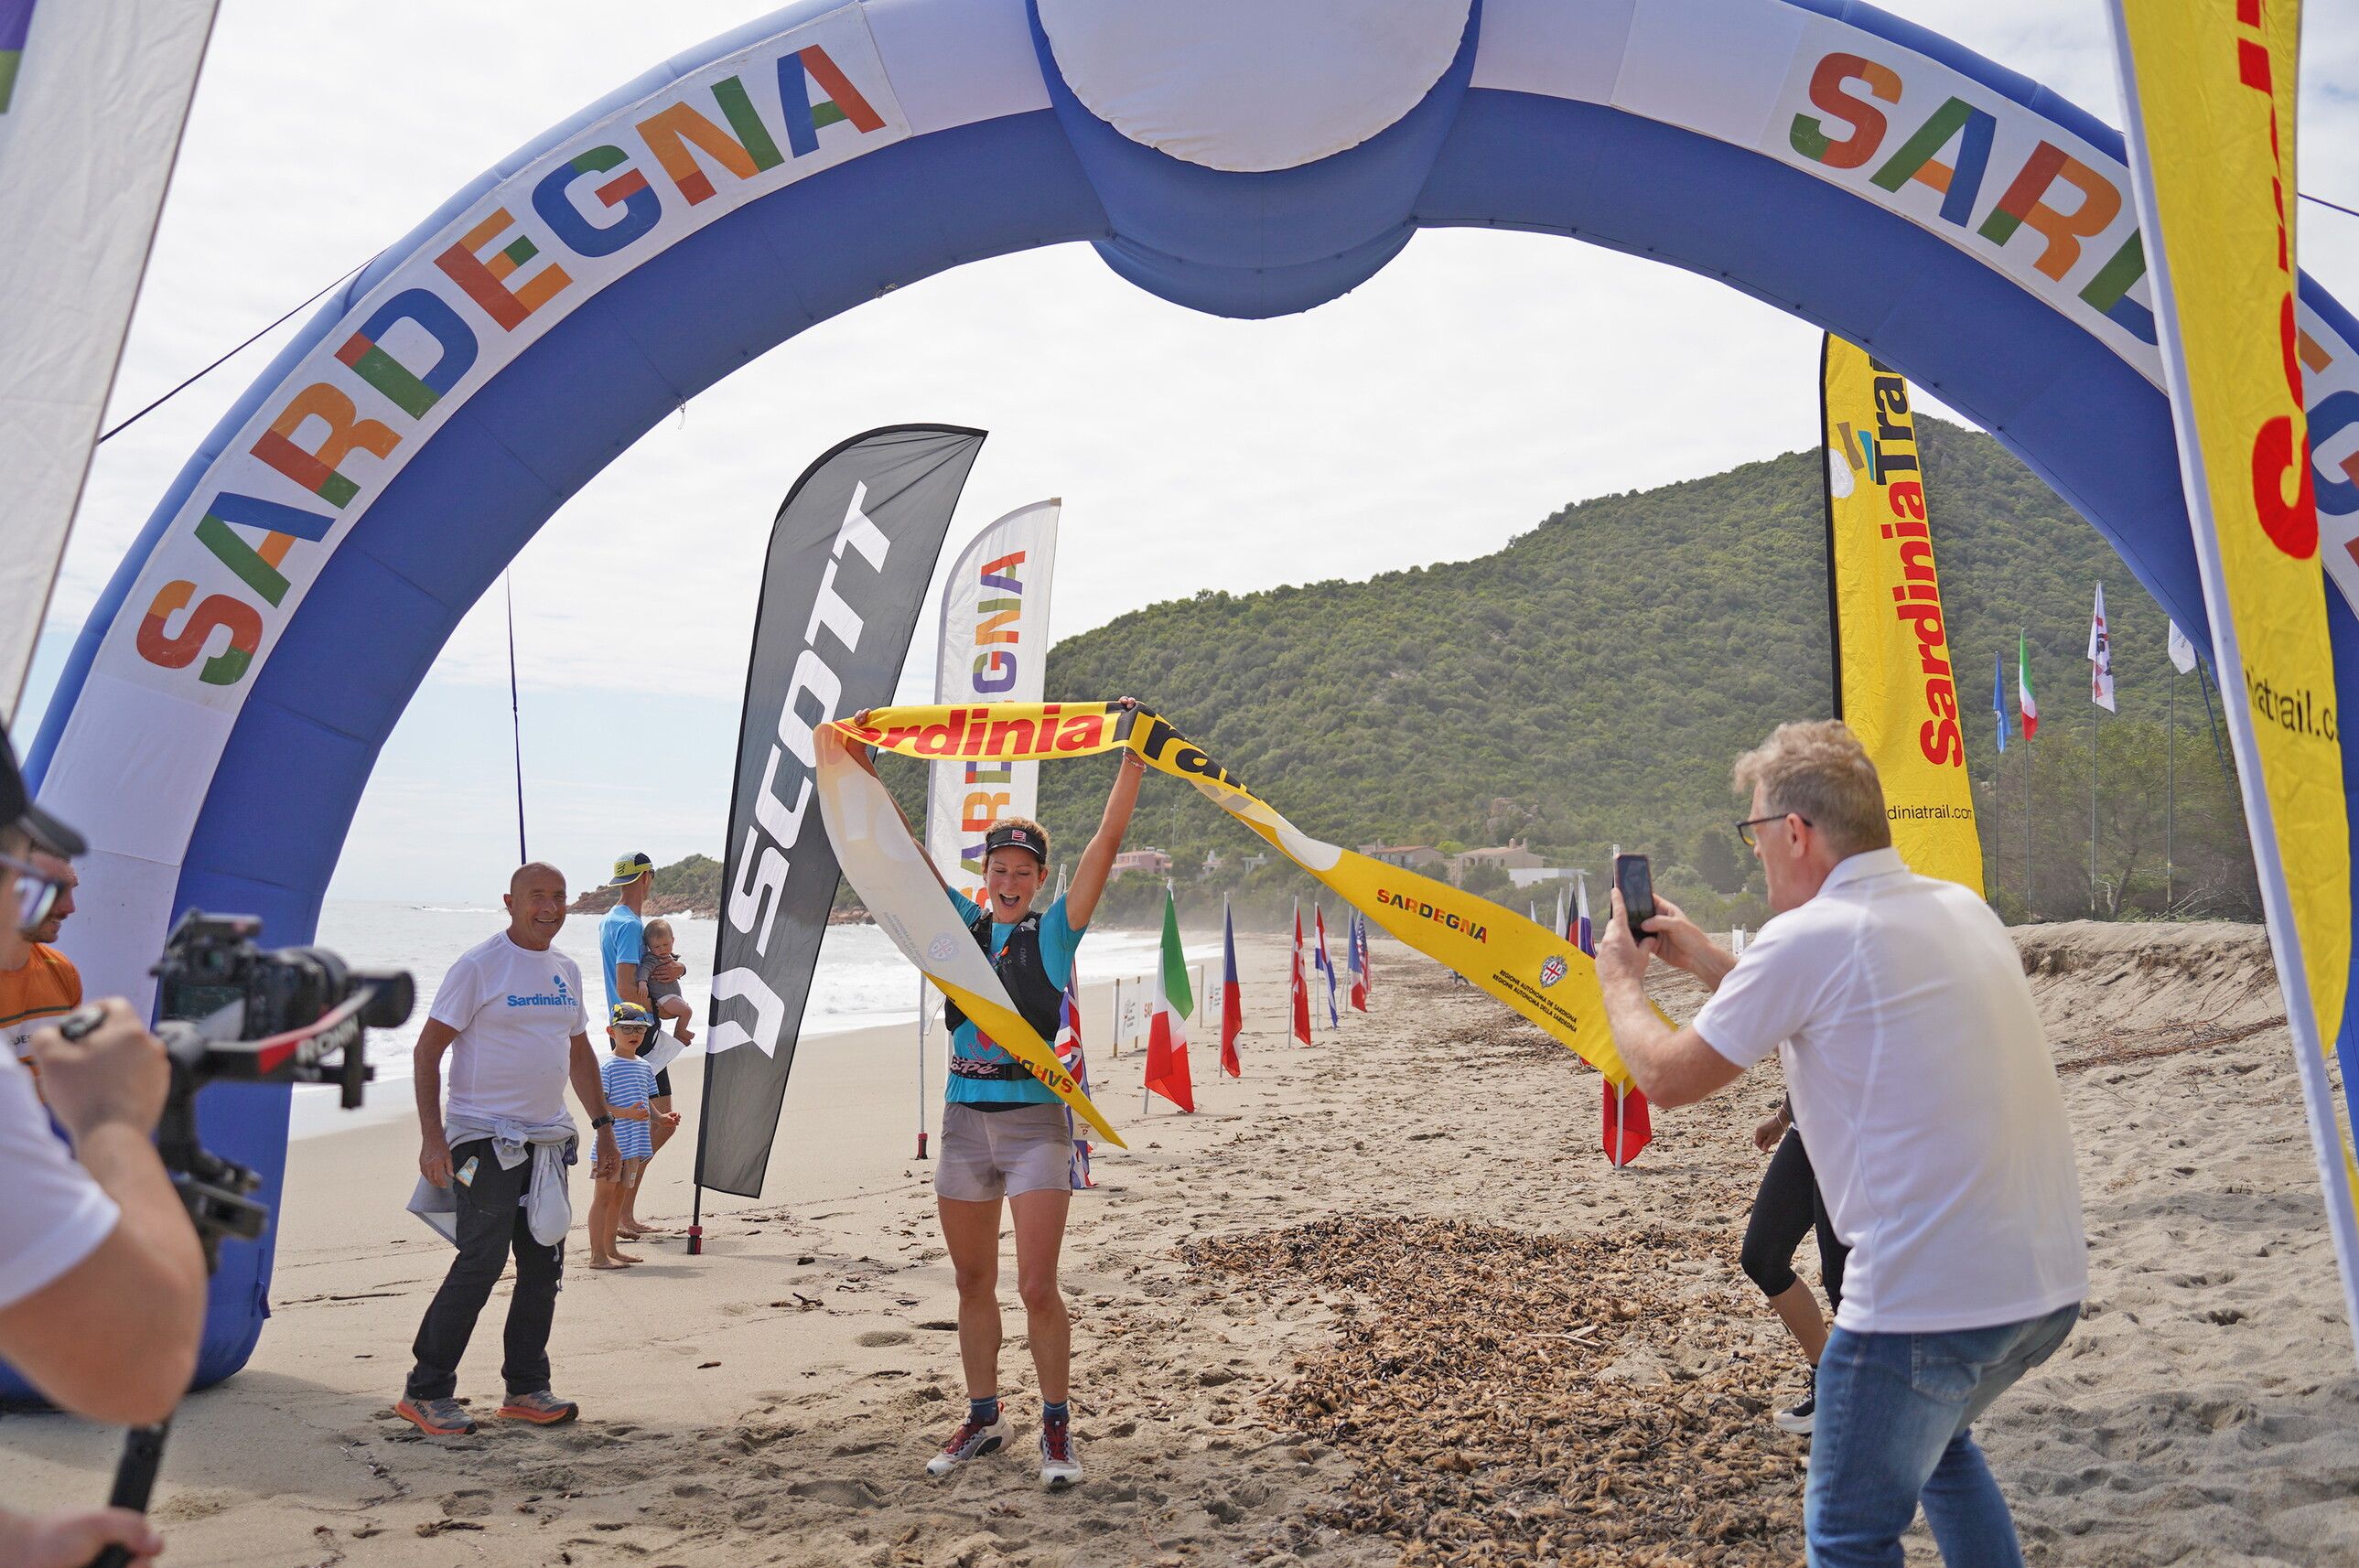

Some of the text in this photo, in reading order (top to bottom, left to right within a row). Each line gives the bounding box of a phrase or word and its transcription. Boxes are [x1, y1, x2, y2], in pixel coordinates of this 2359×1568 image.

[135, 43, 888, 687] SARDEGNA
[728, 479, 891, 958] SCOTT
[1376, 888, 1488, 944] SARDEGNA
